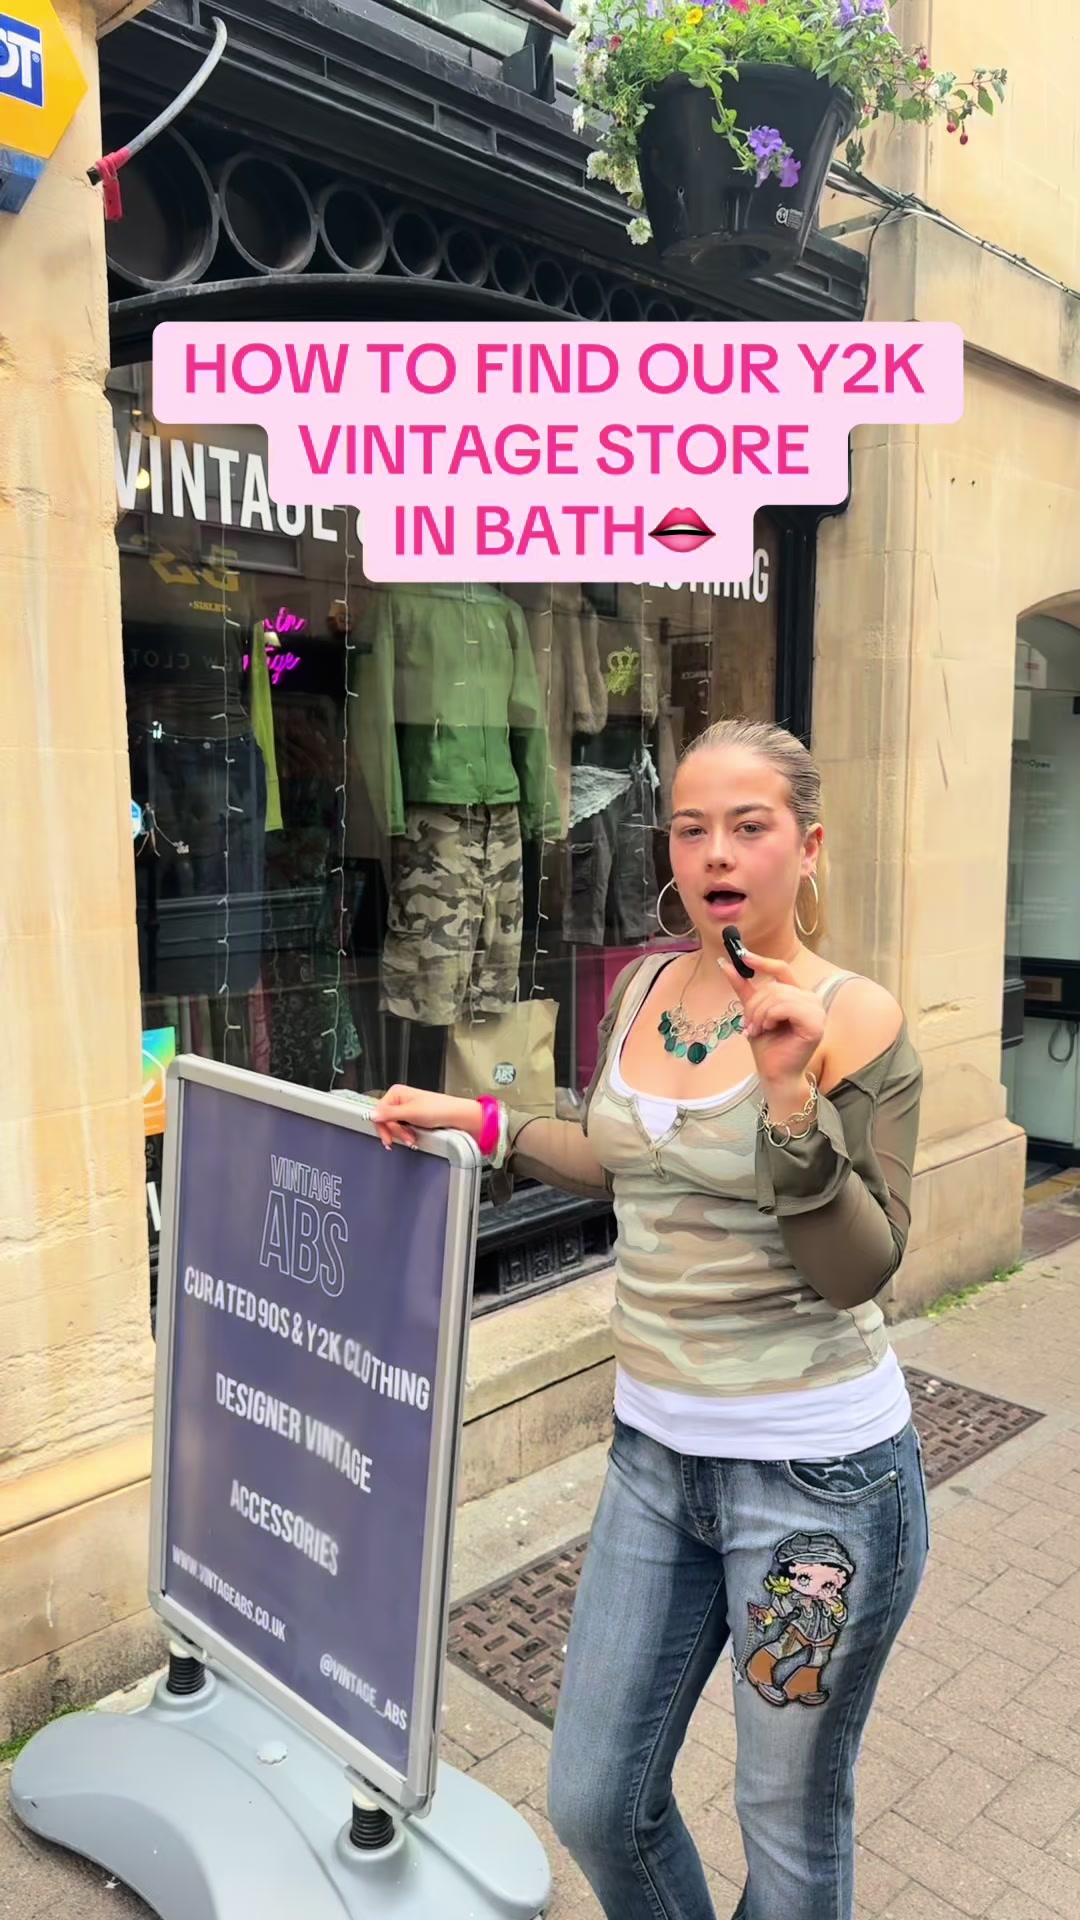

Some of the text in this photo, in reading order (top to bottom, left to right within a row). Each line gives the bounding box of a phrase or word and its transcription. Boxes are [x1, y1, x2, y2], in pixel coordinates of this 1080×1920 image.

[271, 1154, 342, 1209] VINTAGE
[259, 1190, 349, 1298] ABS
[184, 1265, 431, 1411] CURATED 90S & Y2K CLOTHING
[215, 1371, 373, 1493] DESIGNER VINTAGE
[229, 1478, 340, 1577] ACCESSORIES
[172, 1544, 286, 1643] WWW.VINTAGEABS.CO.UK
[319, 1653, 408, 1731] @VINTAGE_ABS
